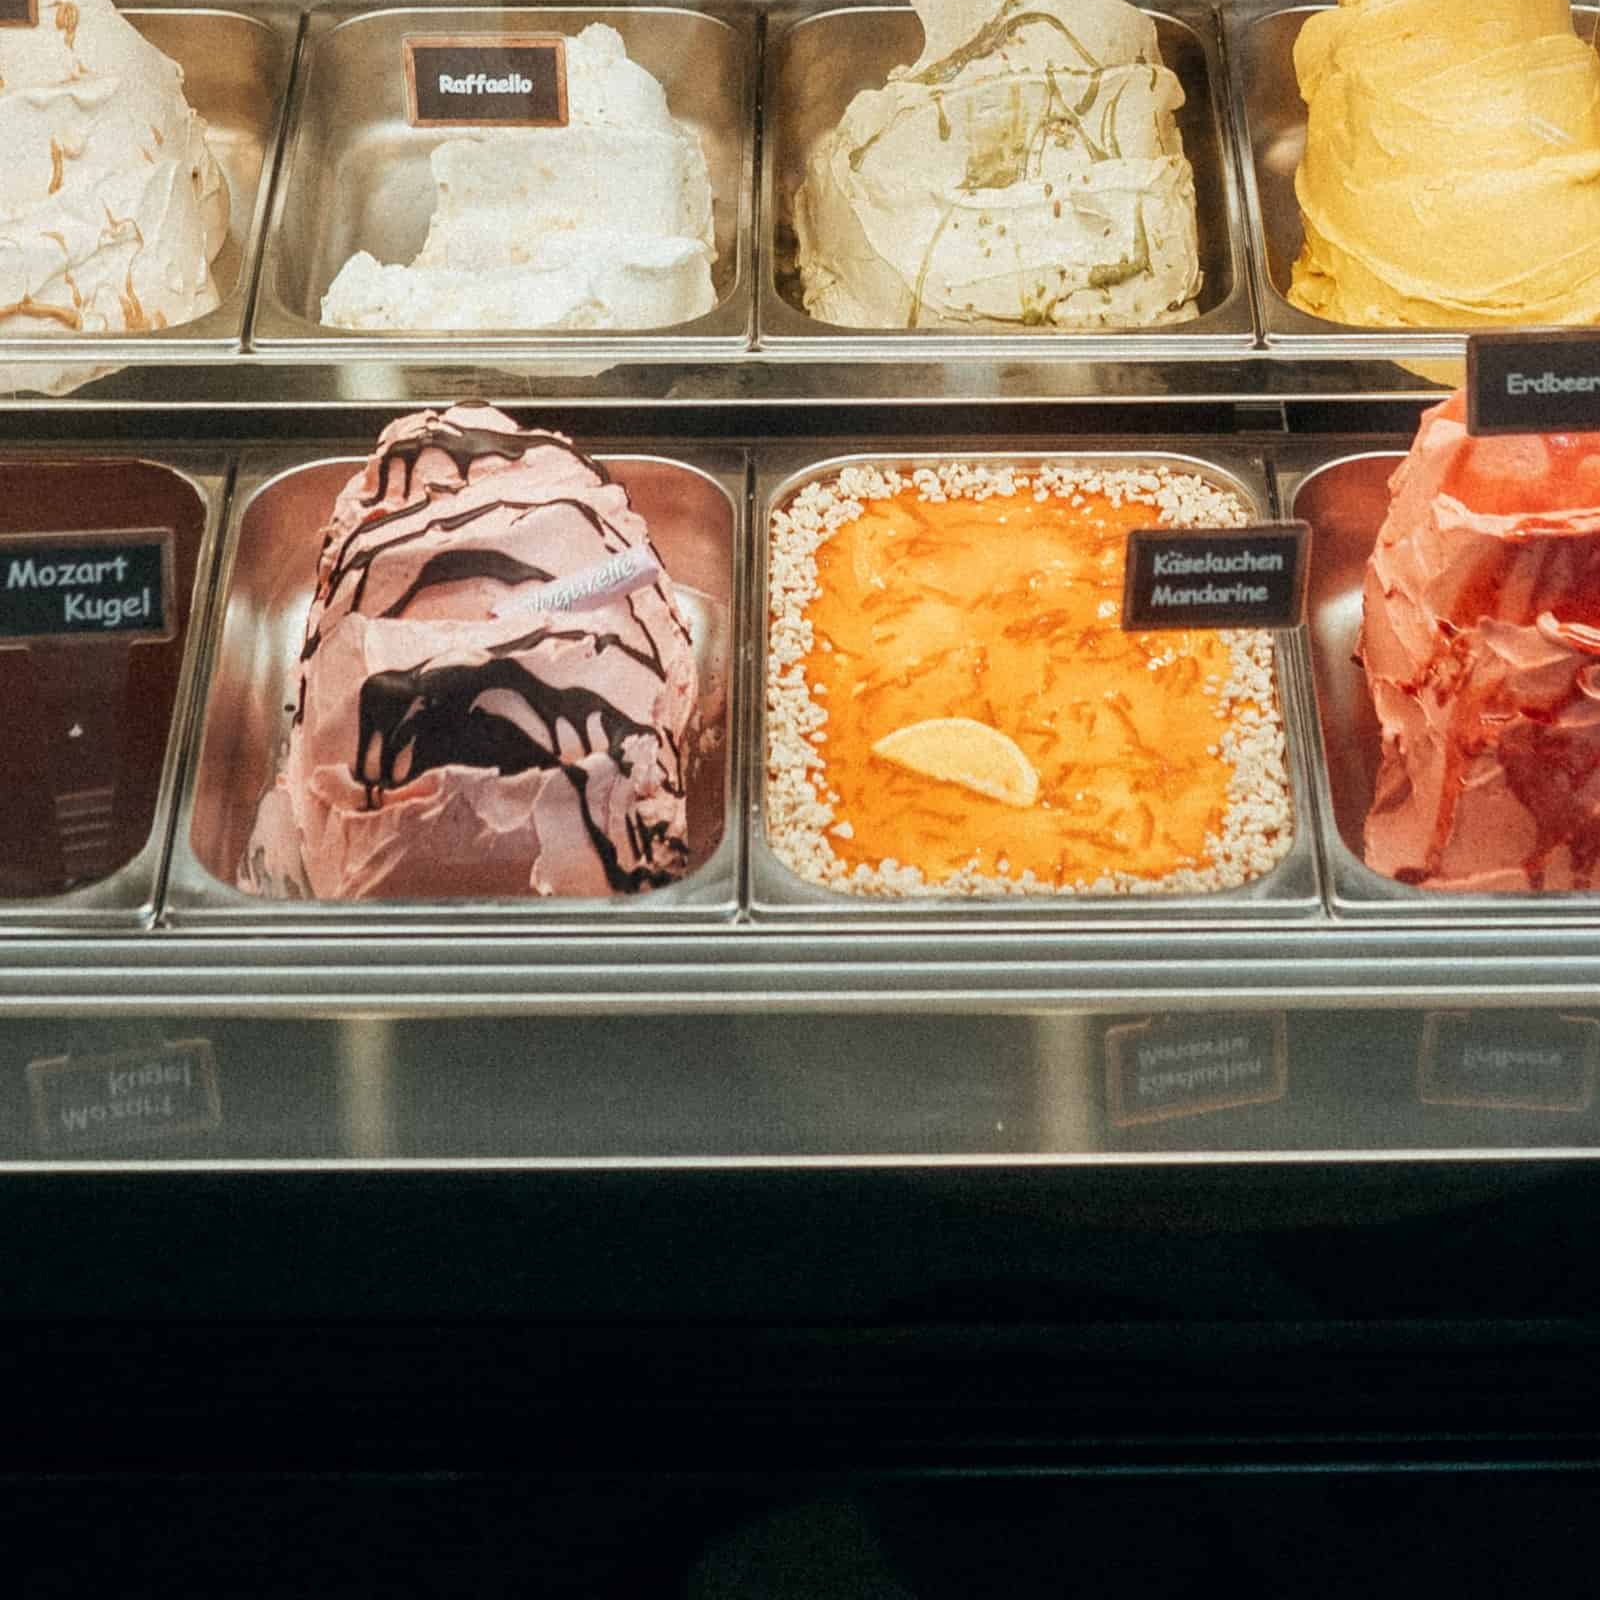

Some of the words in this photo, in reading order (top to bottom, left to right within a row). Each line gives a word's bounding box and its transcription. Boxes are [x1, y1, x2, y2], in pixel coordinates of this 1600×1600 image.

[438, 73, 533, 95] Raffaello
[7, 556, 128, 589] Mozart
[1153, 550, 1284, 576] Käsekuchen
[64, 587, 150, 627] Kugel
[1151, 582, 1269, 606] Mandarine
